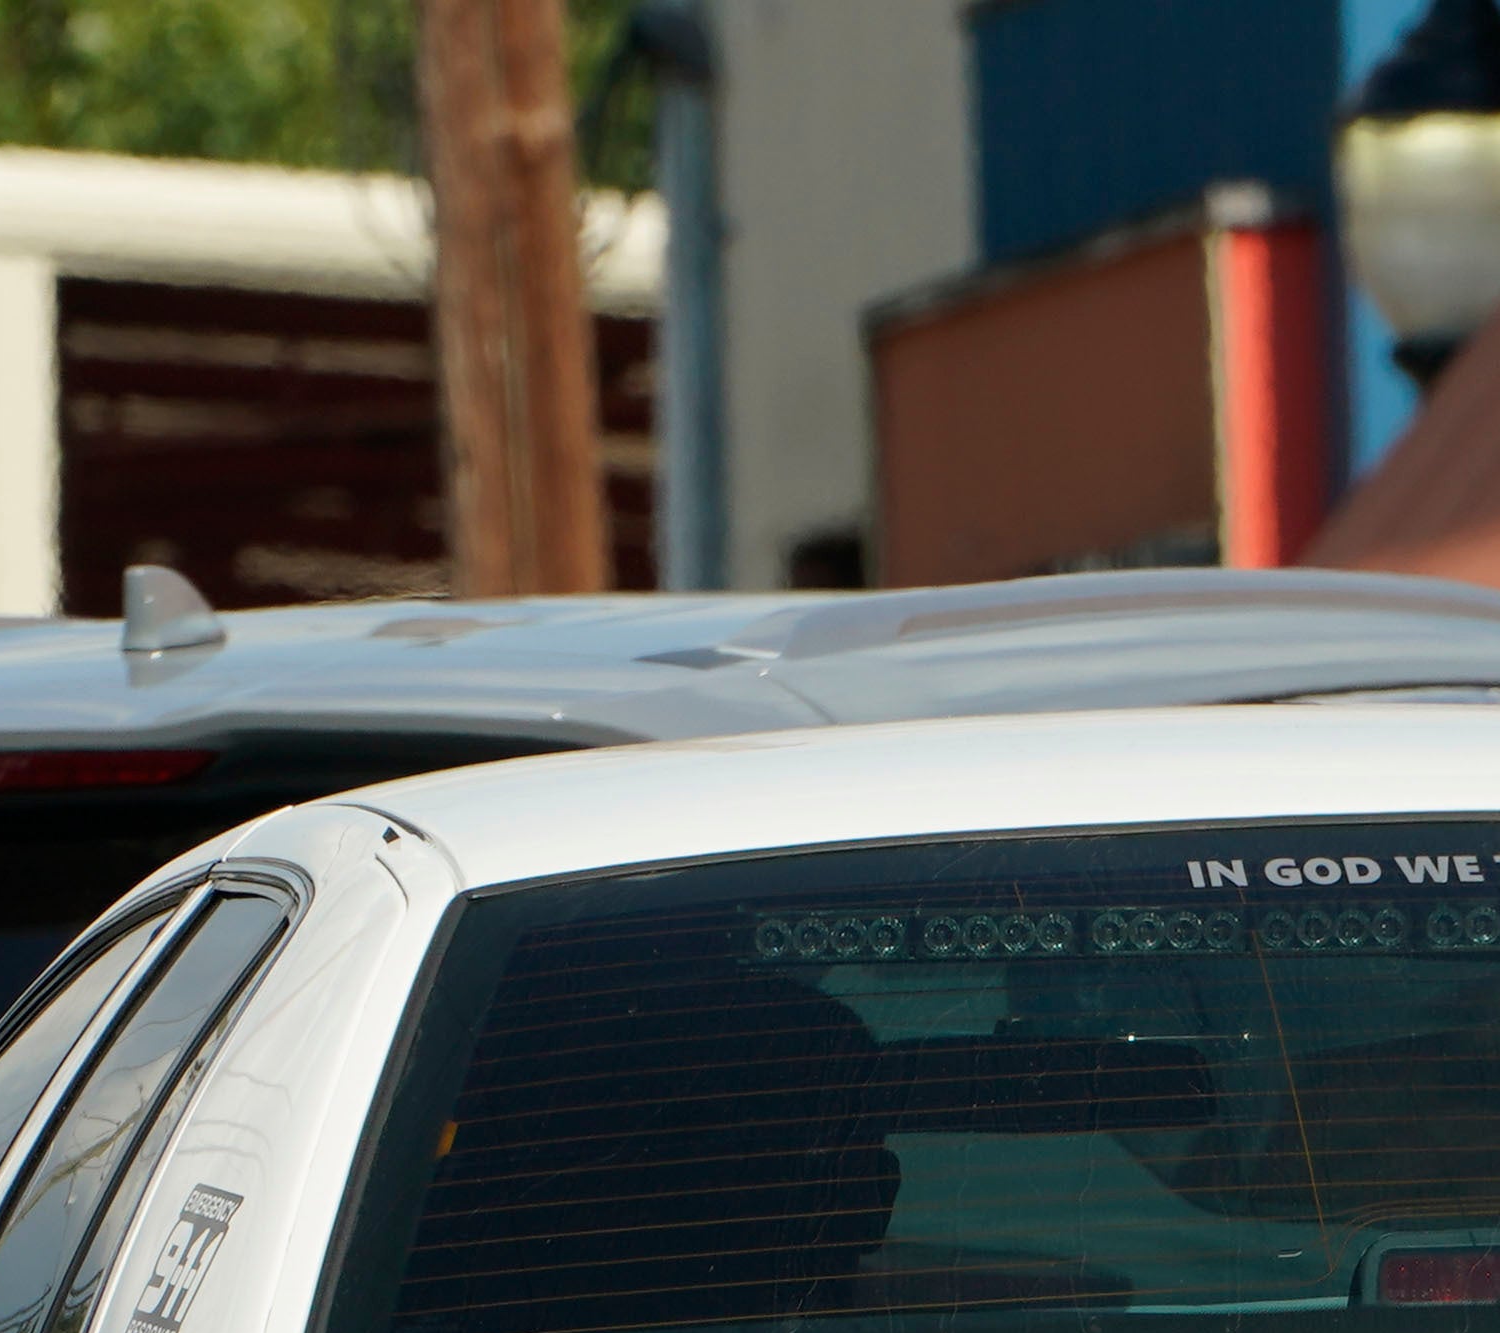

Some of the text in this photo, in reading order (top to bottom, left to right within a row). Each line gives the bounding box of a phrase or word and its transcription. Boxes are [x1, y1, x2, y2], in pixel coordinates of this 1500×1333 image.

[1187, 859, 1249, 889] IN
[1263, 857, 1382, 887] GOD
[1394, 854, 1484, 885] WE
[137, 1220, 225, 1323] 911
